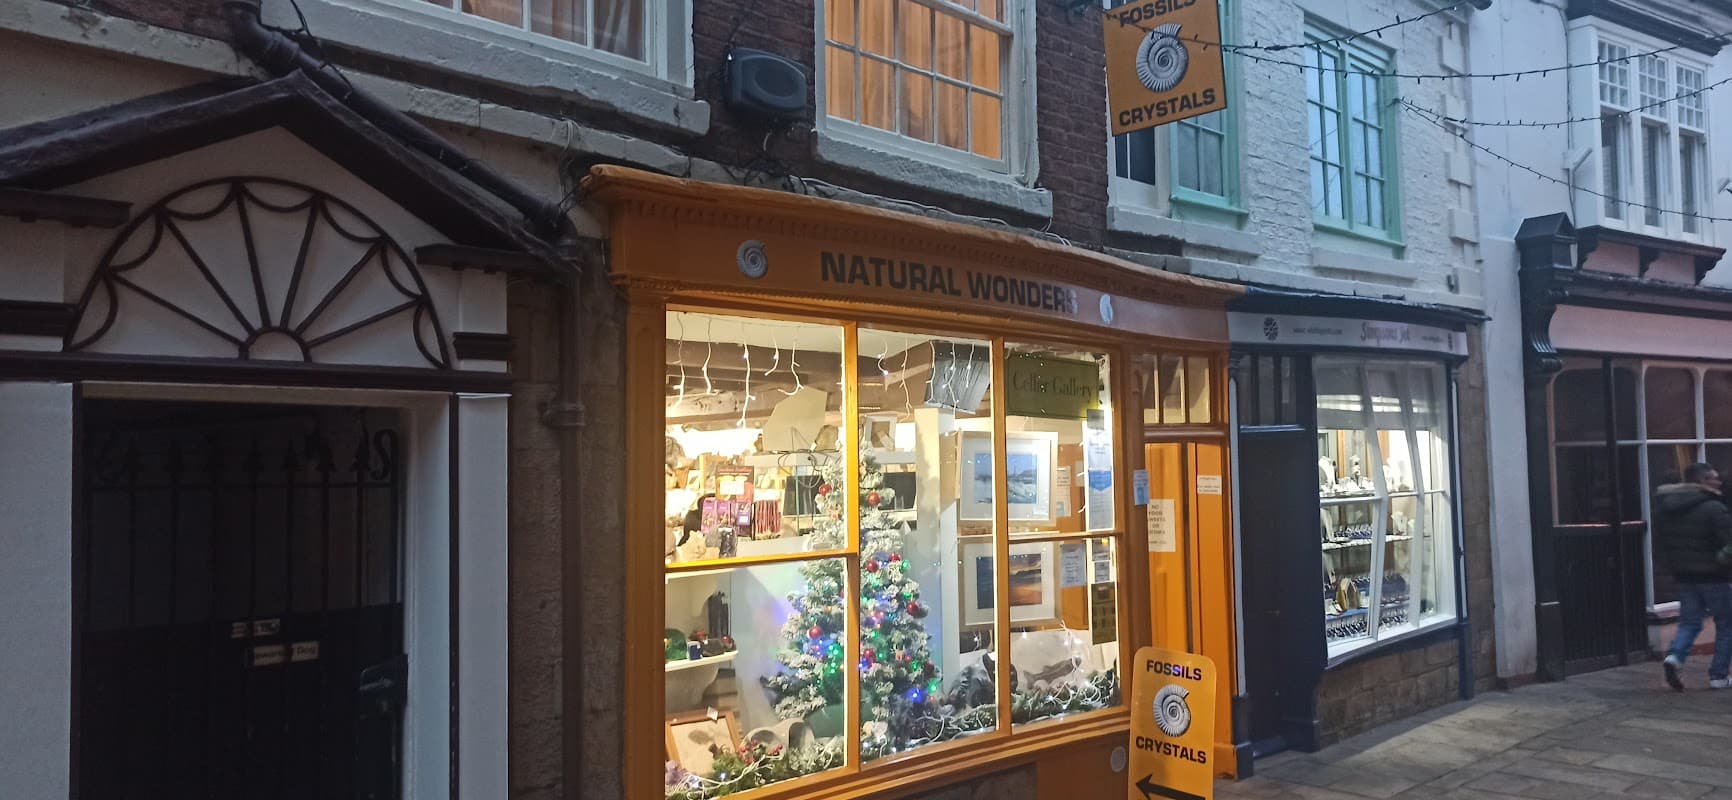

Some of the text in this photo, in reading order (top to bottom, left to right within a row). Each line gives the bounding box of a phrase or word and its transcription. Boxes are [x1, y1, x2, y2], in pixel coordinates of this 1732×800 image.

[1119, 88, 1216, 126] CRYSTALS
[820, 251, 1079, 315] NATURAL WONDERS
[1053, 376, 1092, 398] Gallery
[1146, 659, 1202, 681] FOSSILS
[1135, 736, 1207, 764] CRYSTALS
